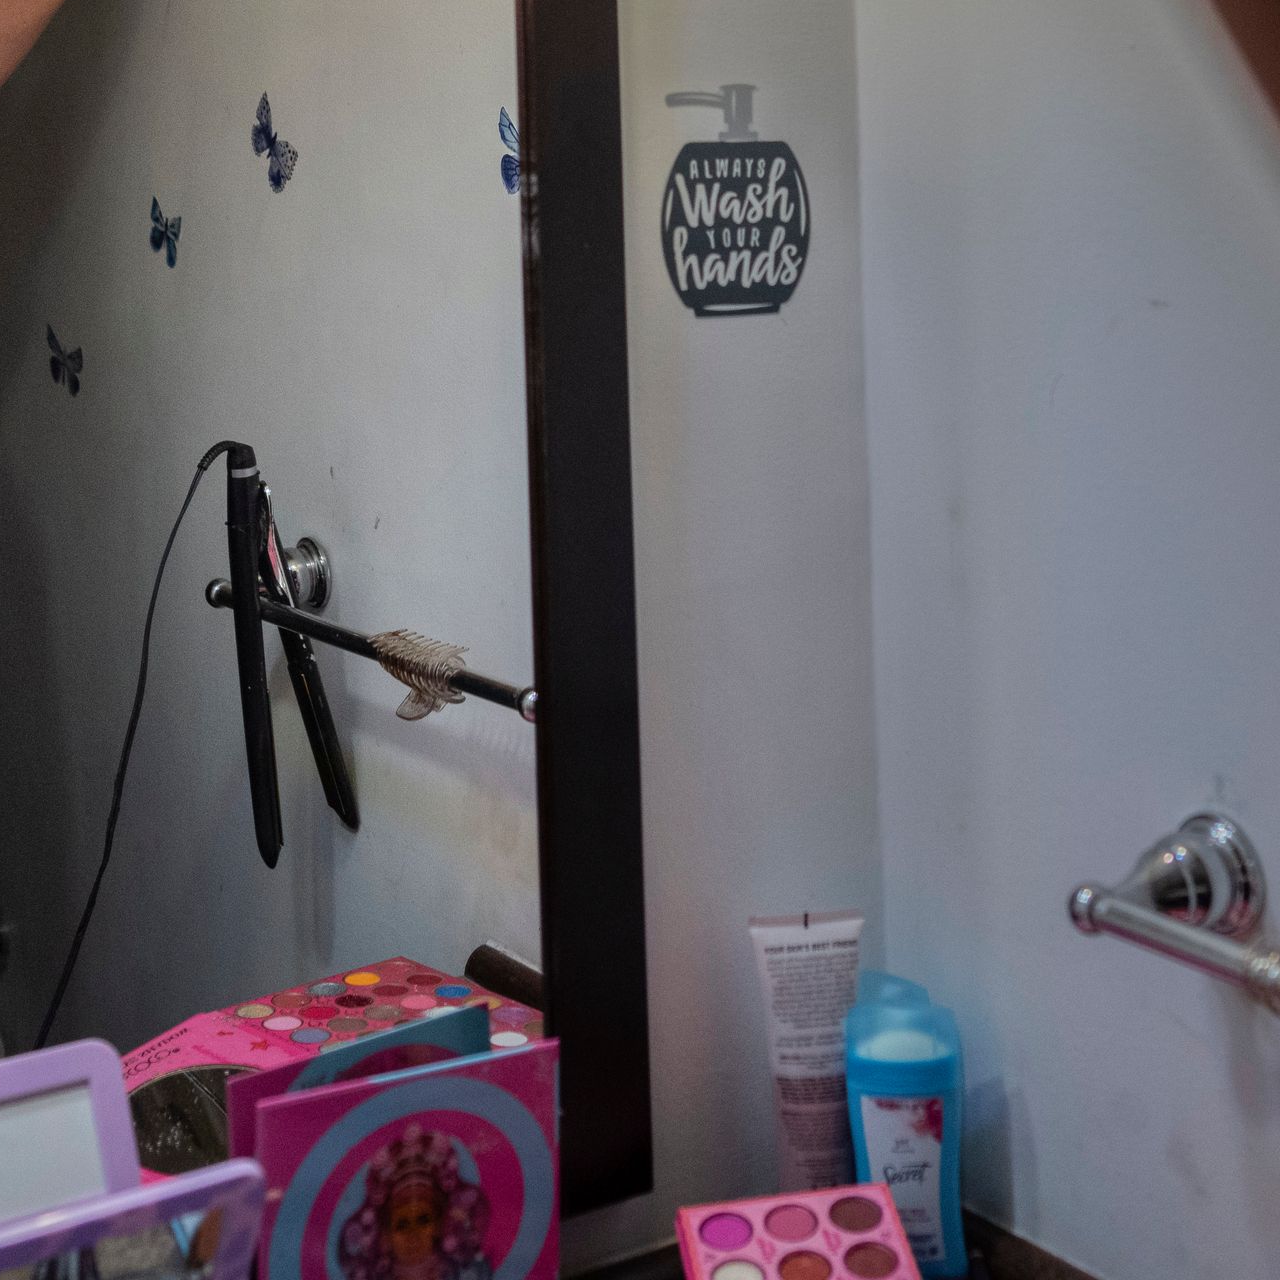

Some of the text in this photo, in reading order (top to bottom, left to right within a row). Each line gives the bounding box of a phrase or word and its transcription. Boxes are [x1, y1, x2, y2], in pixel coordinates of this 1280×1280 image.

[689, 158, 767, 180] ALWAYS
[675, 157, 795, 228] Wash
[705, 227, 760, 249] YOUR
[673, 225, 803, 291] hands
[883, 1161, 933, 1185] Secret
